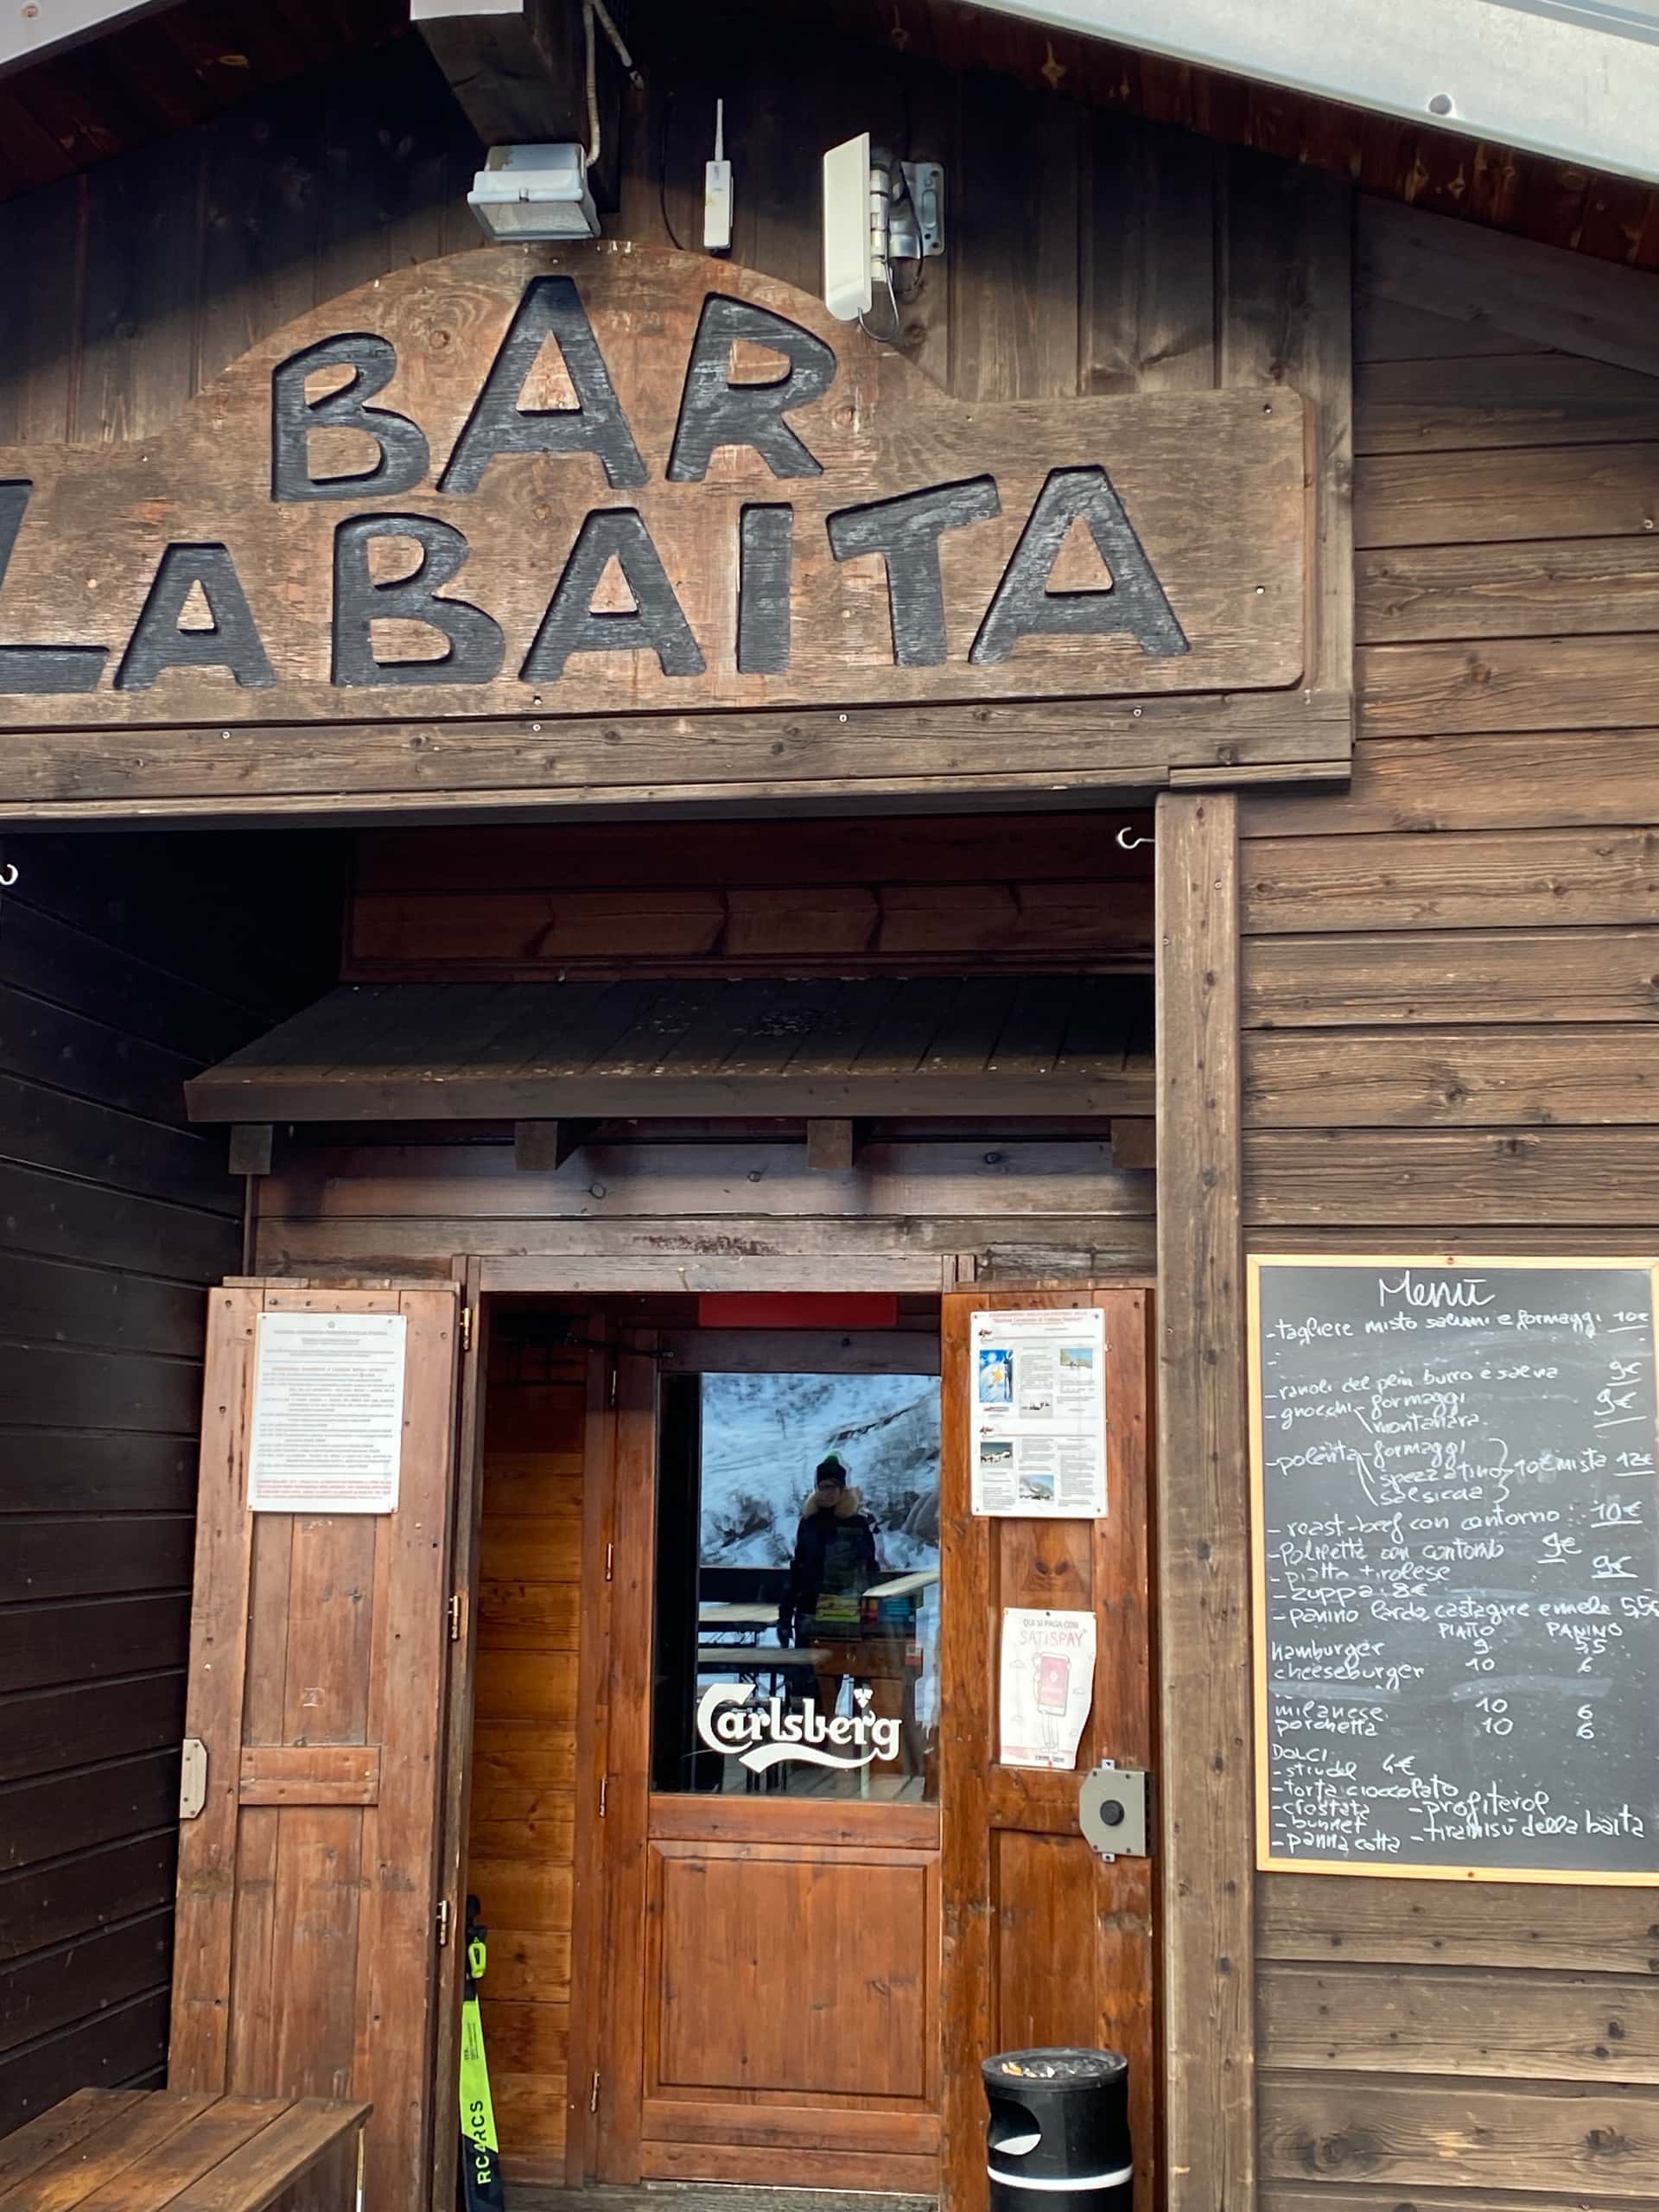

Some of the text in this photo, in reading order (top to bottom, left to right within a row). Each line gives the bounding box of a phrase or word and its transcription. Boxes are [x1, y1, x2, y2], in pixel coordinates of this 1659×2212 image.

[271, 275, 836, 501] BAR
[0, 464, 1191, 694] LA BAITA
[1365, 1311, 1417, 1333] misto
[1426, 1313, 1490, 1329] salumi
[1497, 1314, 1514, 1325] e
[1516, 1309, 1601, 1338] formaggi
[1612, 1312, 1649, 1323] 10€
[1342, 1375, 1370, 1393] del
[1424, 1369, 1473, 1384] burro
[1371, 1391, 1465, 1421] formaggi
[1373, 1440, 1465, 1469] formaggi
[1556, 1447, 1608, 1473] mista
[1409, 1516, 1450, 1530] con
[1461, 1503, 1560, 1531] contorno
[1434, 1594, 1530, 1625] castagne
[1437, 1622, 1624, 1640] PIATTO PANINO
[1271, 1638, 1385, 1669] hamburger
[1273, 1657, 1593, 1690] cheeseburger 10 6
[1274, 1697, 1593, 1722] milanese 10 6
[697, 1682, 903, 1773] Carlsberg
[1274, 1717, 1595, 1739] porchetta 10 6
[1271, 1743, 1328, 1762] DOLCI
[1346, 1774, 1459, 1799] cioccolato
[1522, 1815, 1579, 1837] della
[1586, 1803, 1645, 1838] baita
[1354, 1828, 1402, 1853] cotta
